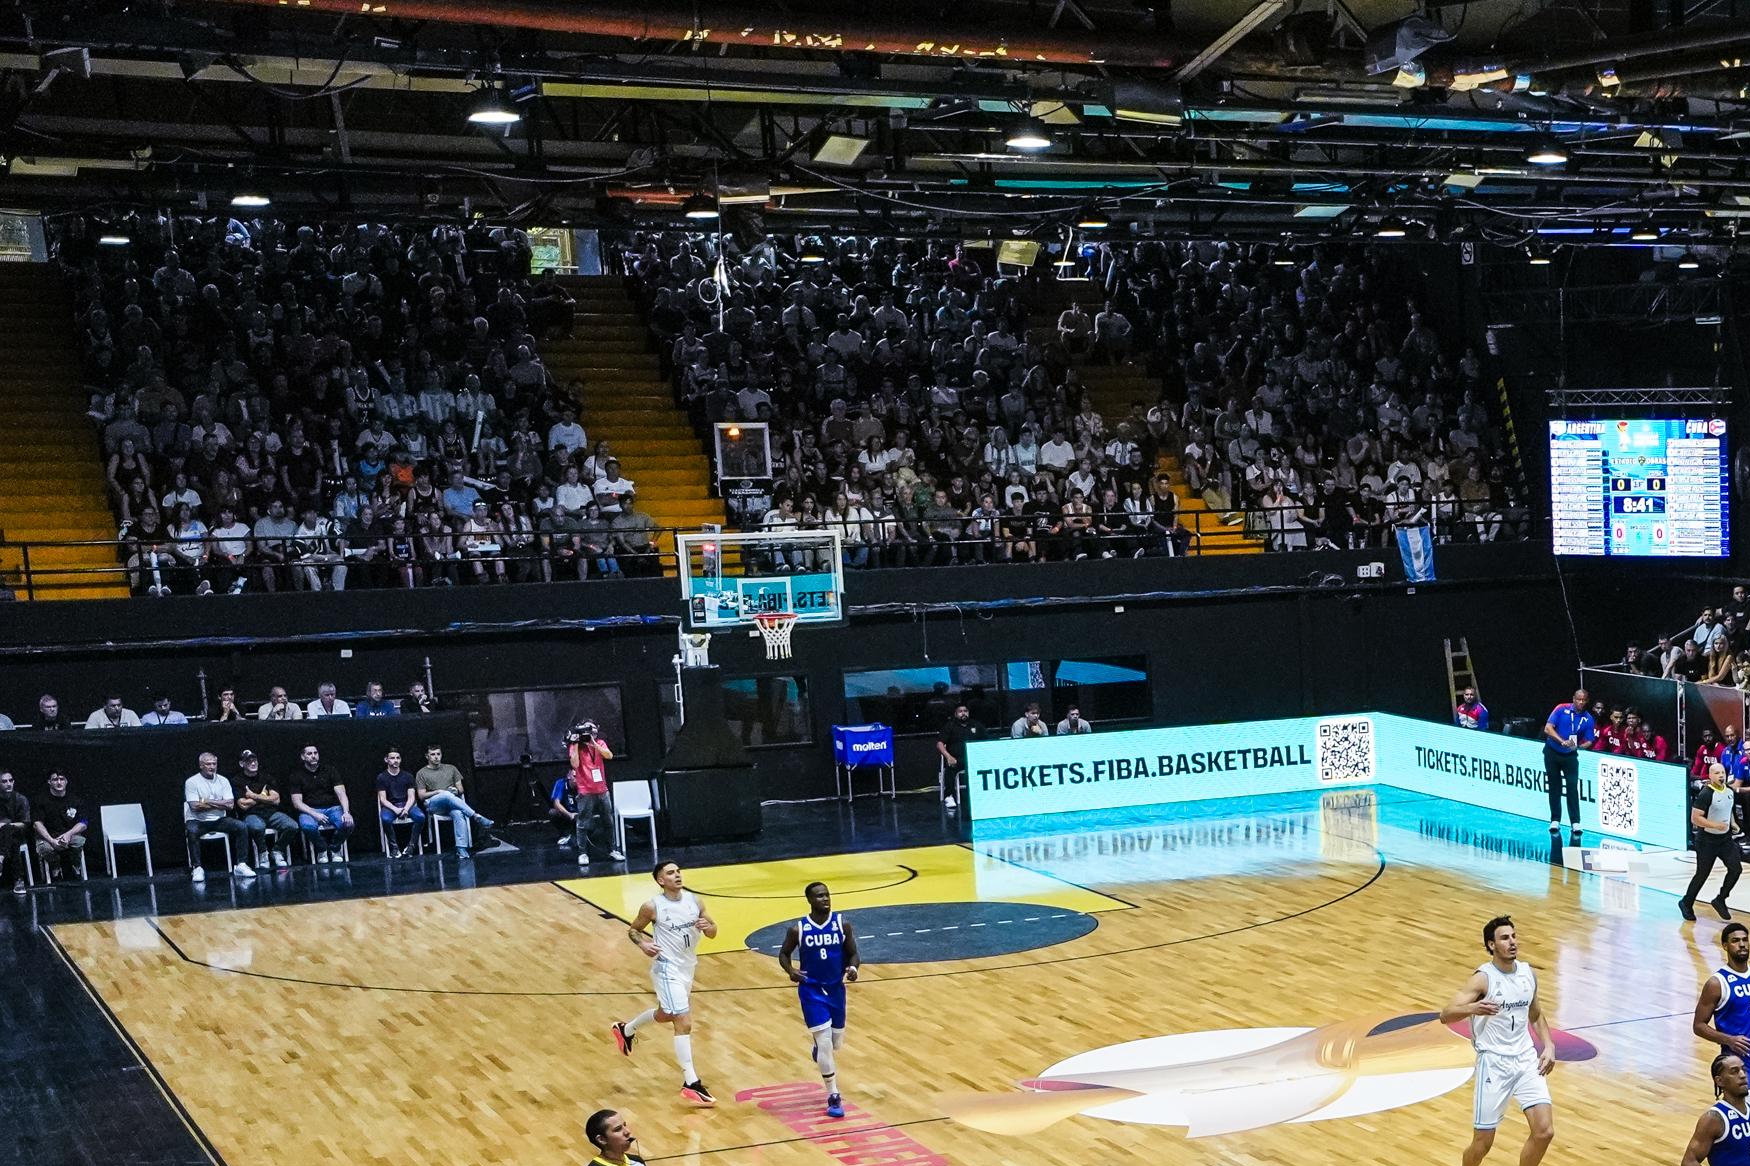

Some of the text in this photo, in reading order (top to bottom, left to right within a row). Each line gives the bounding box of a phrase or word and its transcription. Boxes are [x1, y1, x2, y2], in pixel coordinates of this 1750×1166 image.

[1685, 421, 1708, 434] CUBA
[1616, 479, 1626, 491] 0
[1652, 479, 1661, 491] 0
[1622, 497, 1654, 513] 8:41
[852, 740, 888, 752] molten
[976, 744, 1312, 791] TICKETS.FIBA.BASKETBALL
[683, 934, 690, 948] 11
[805, 933, 840, 947] CUBA
[820, 948, 828, 960] 8
[1499, 1000, 1529, 1011] Argentina
[1511, 1015, 1515, 1032] 1
